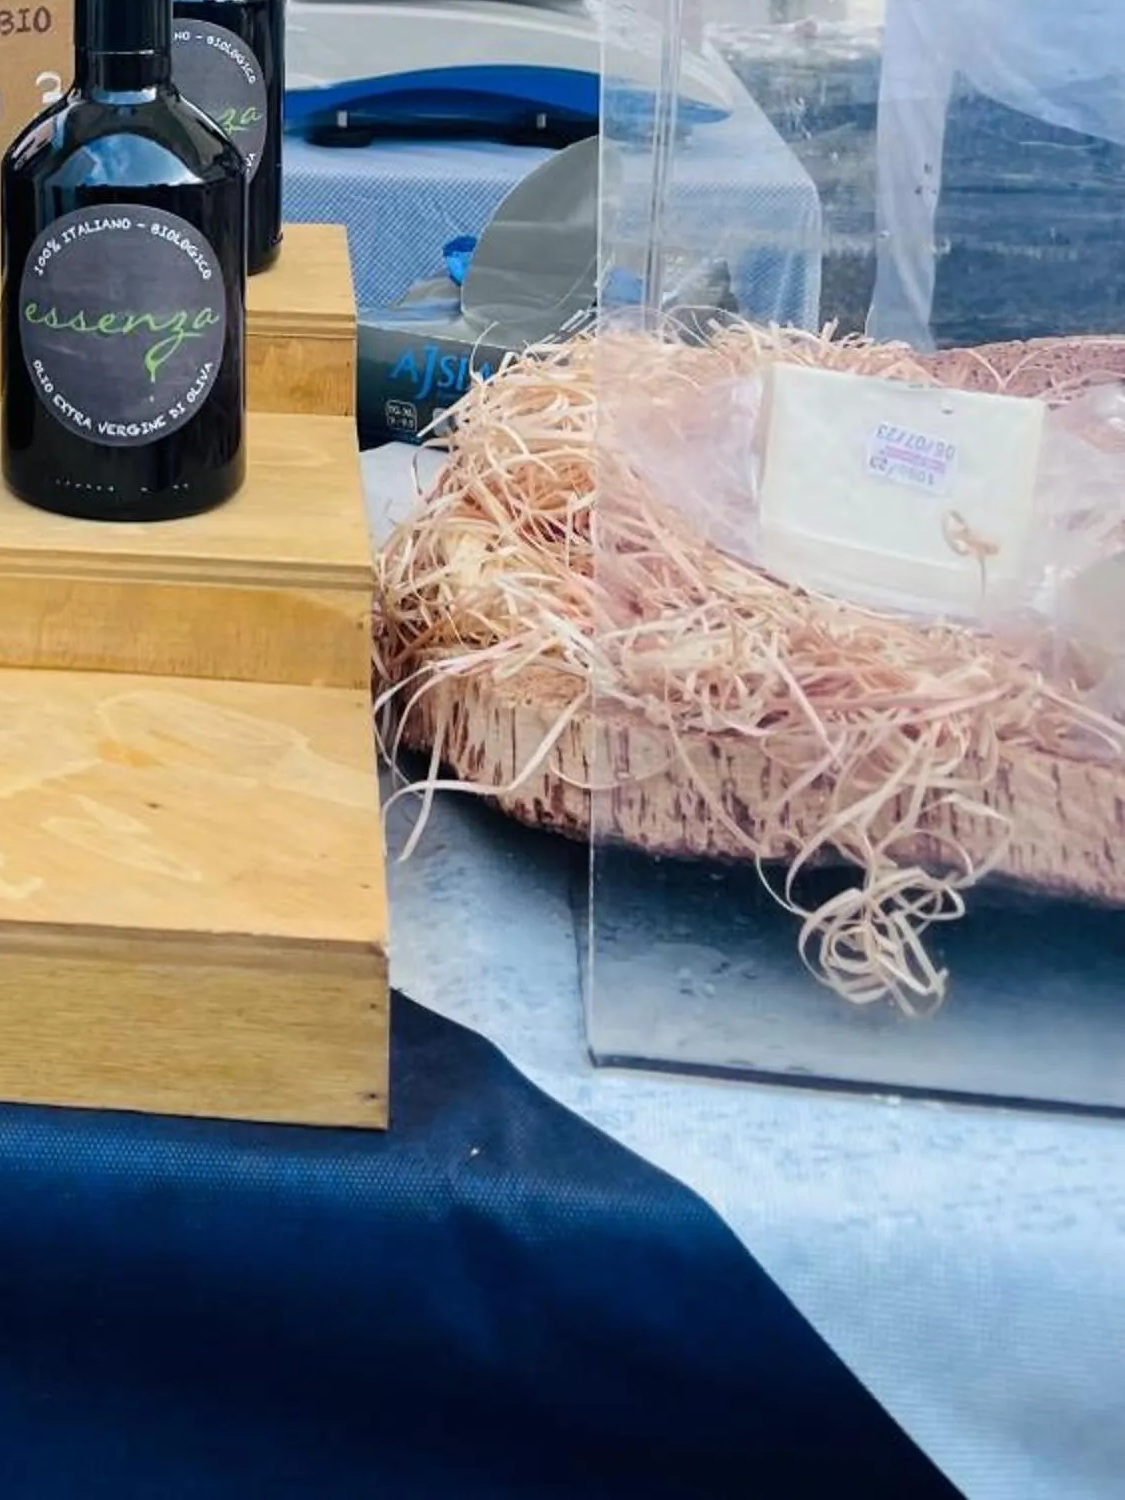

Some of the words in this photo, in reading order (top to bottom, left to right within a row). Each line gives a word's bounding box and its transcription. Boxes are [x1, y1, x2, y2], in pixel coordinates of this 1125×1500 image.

[207, 36, 256, 85] BIOLOGICO
[34, 238, 62, 277] 100%
[62, 218, 132, 243] ITALIANO
[150, 223, 212, 280] BIOLOGICO
[25, 303, 220, 383] essenza
[33, 359, 54, 393] OLIO
[53, 394, 92, 430] EXTRA
[98, 415, 166, 437] VERGINE
[172, 402, 187, 419] DI
[187, 362, 214, 401] OLIVA
